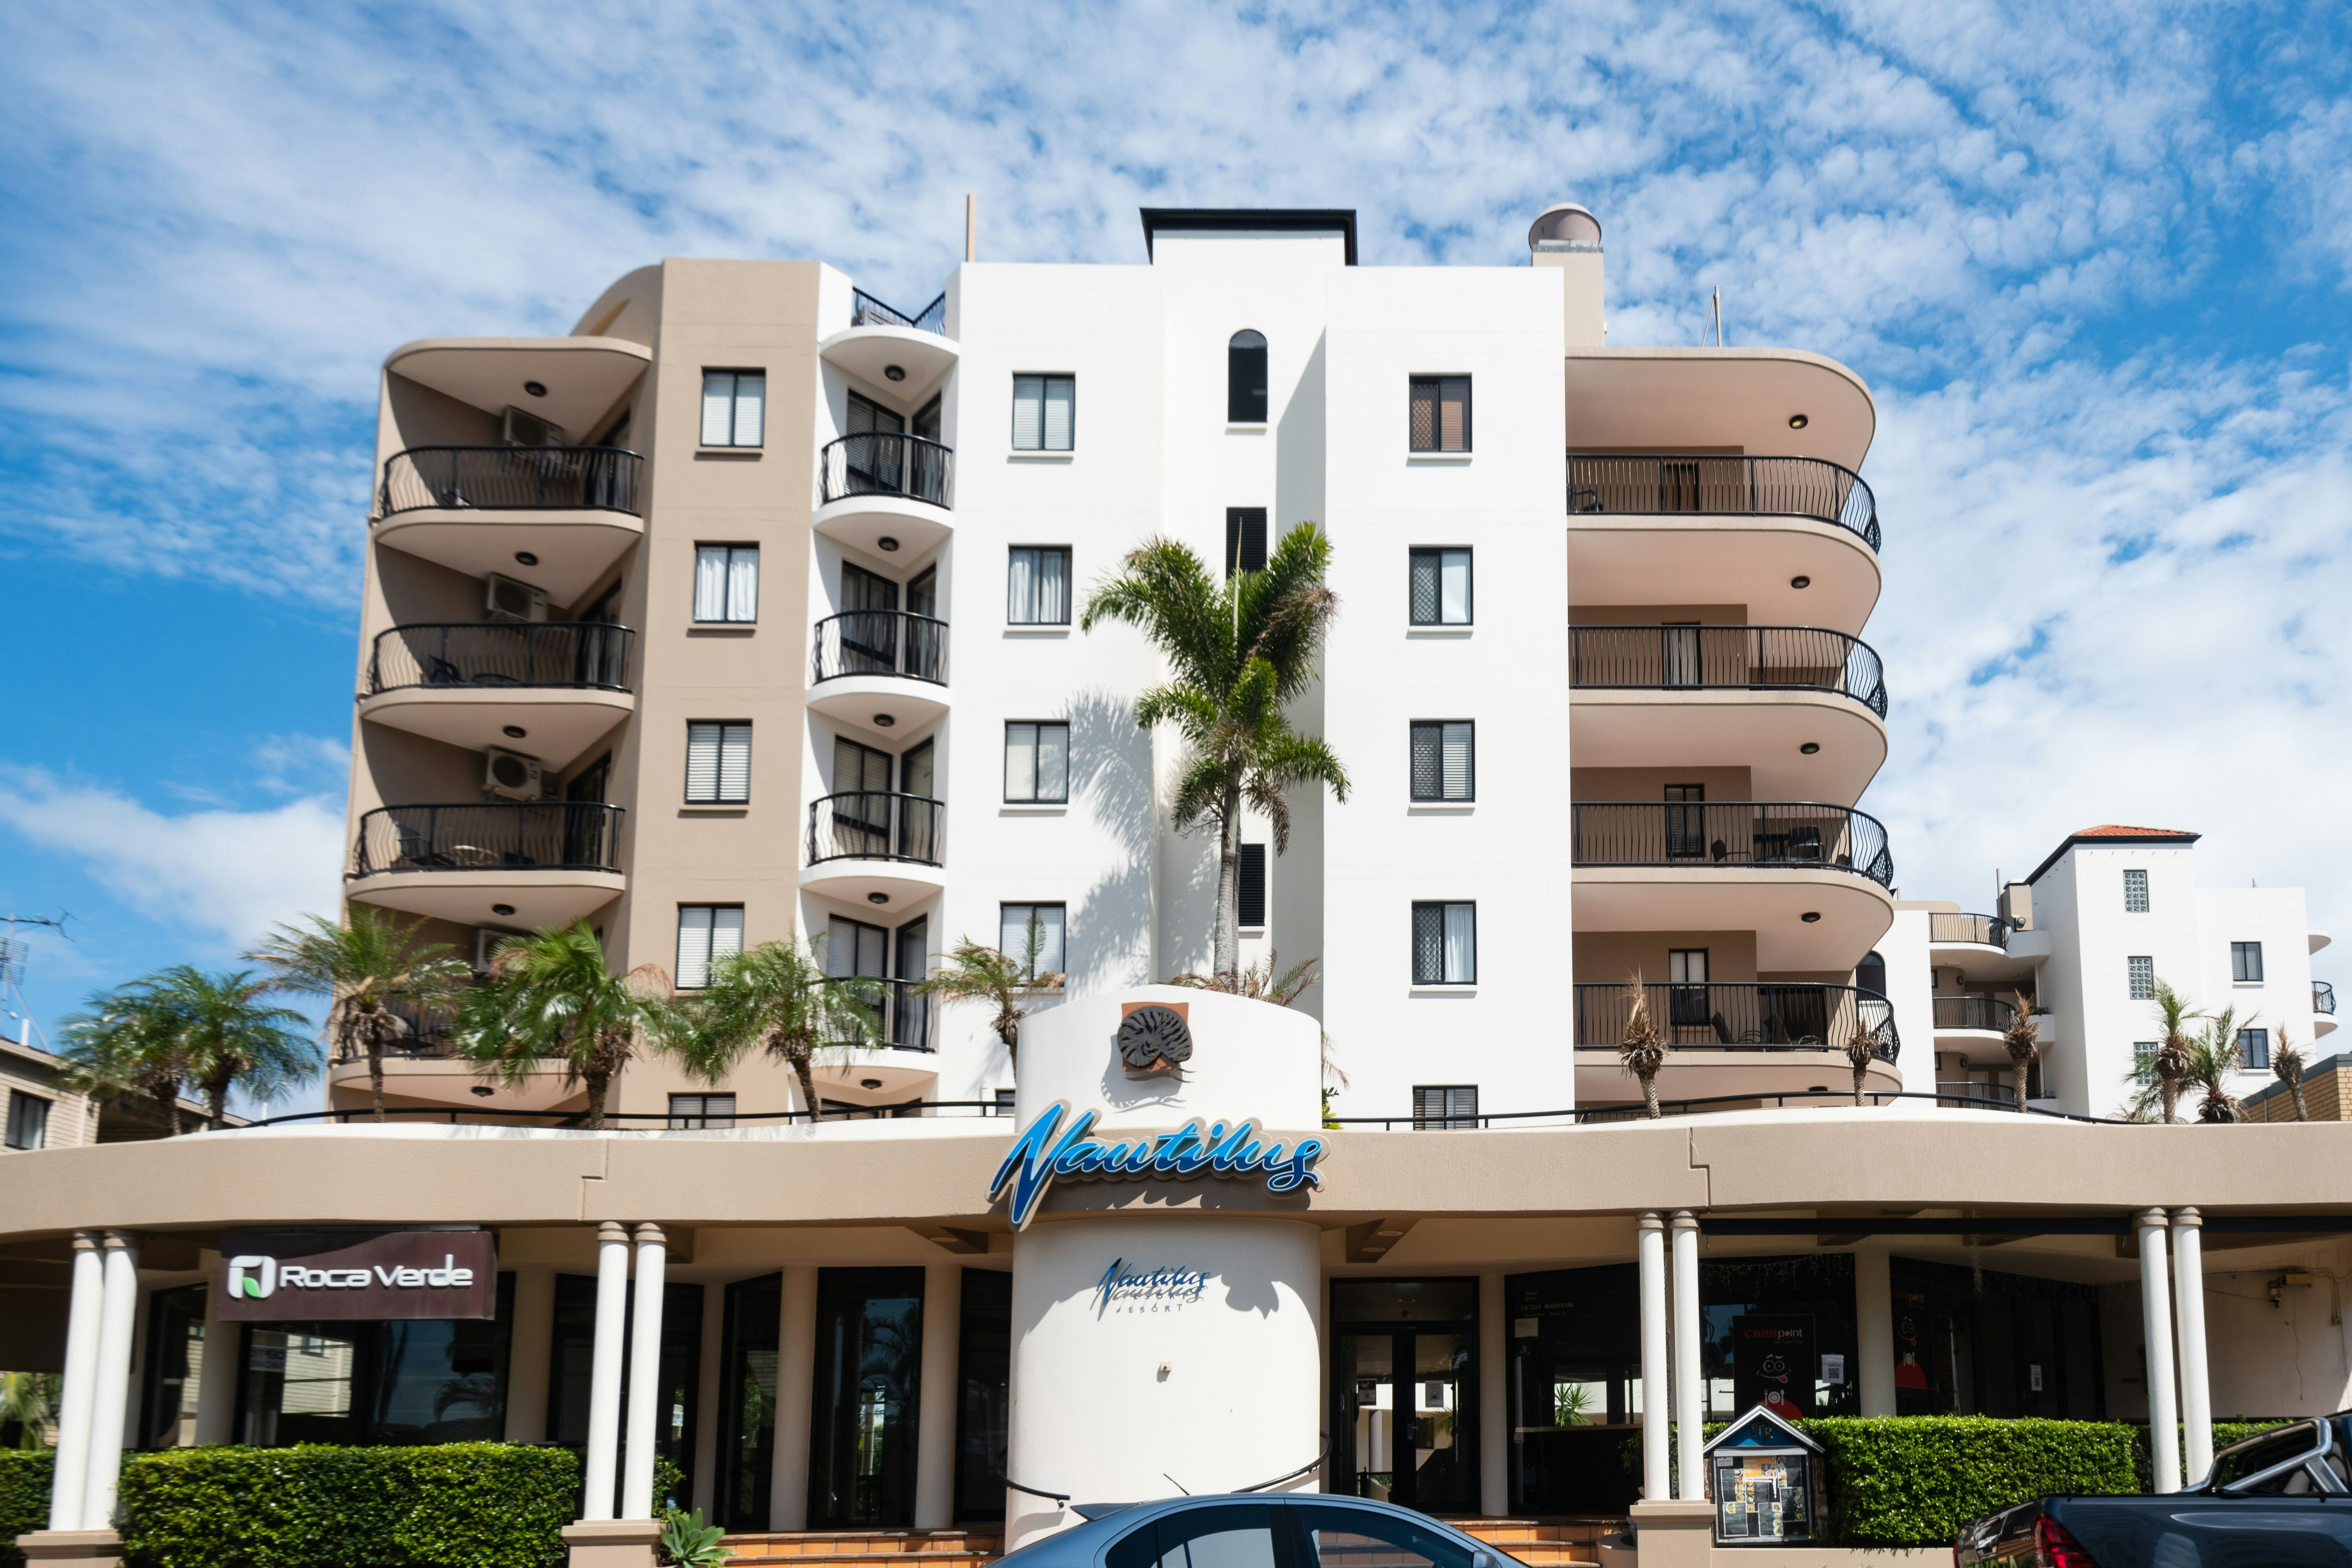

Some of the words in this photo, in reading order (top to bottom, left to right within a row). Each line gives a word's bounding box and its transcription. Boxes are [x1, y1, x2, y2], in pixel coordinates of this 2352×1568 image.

[989, 1102, 1322, 1225] Nautilus
[280, 1266, 371, 1287] Roca
[373, 1254, 473, 1286] Verde
[1096, 1258, 1210, 1306] Nautilus
